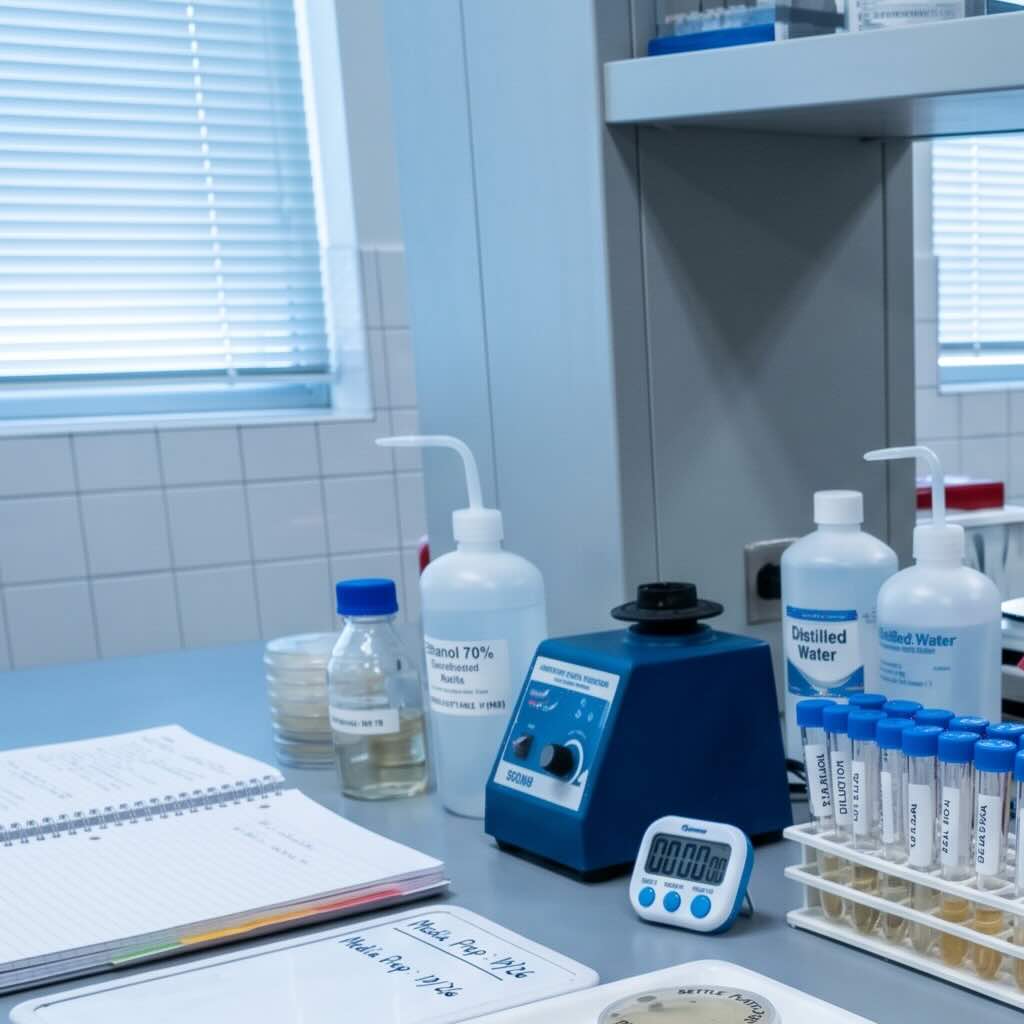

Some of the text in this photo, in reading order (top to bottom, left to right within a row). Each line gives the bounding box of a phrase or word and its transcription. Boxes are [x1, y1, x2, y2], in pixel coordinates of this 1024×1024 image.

[792, 625, 847, 645] Distilled
[915, 633, 957, 647] Water
[463, 646, 494, 660] 70%
[798, 644, 837, 662] Water
